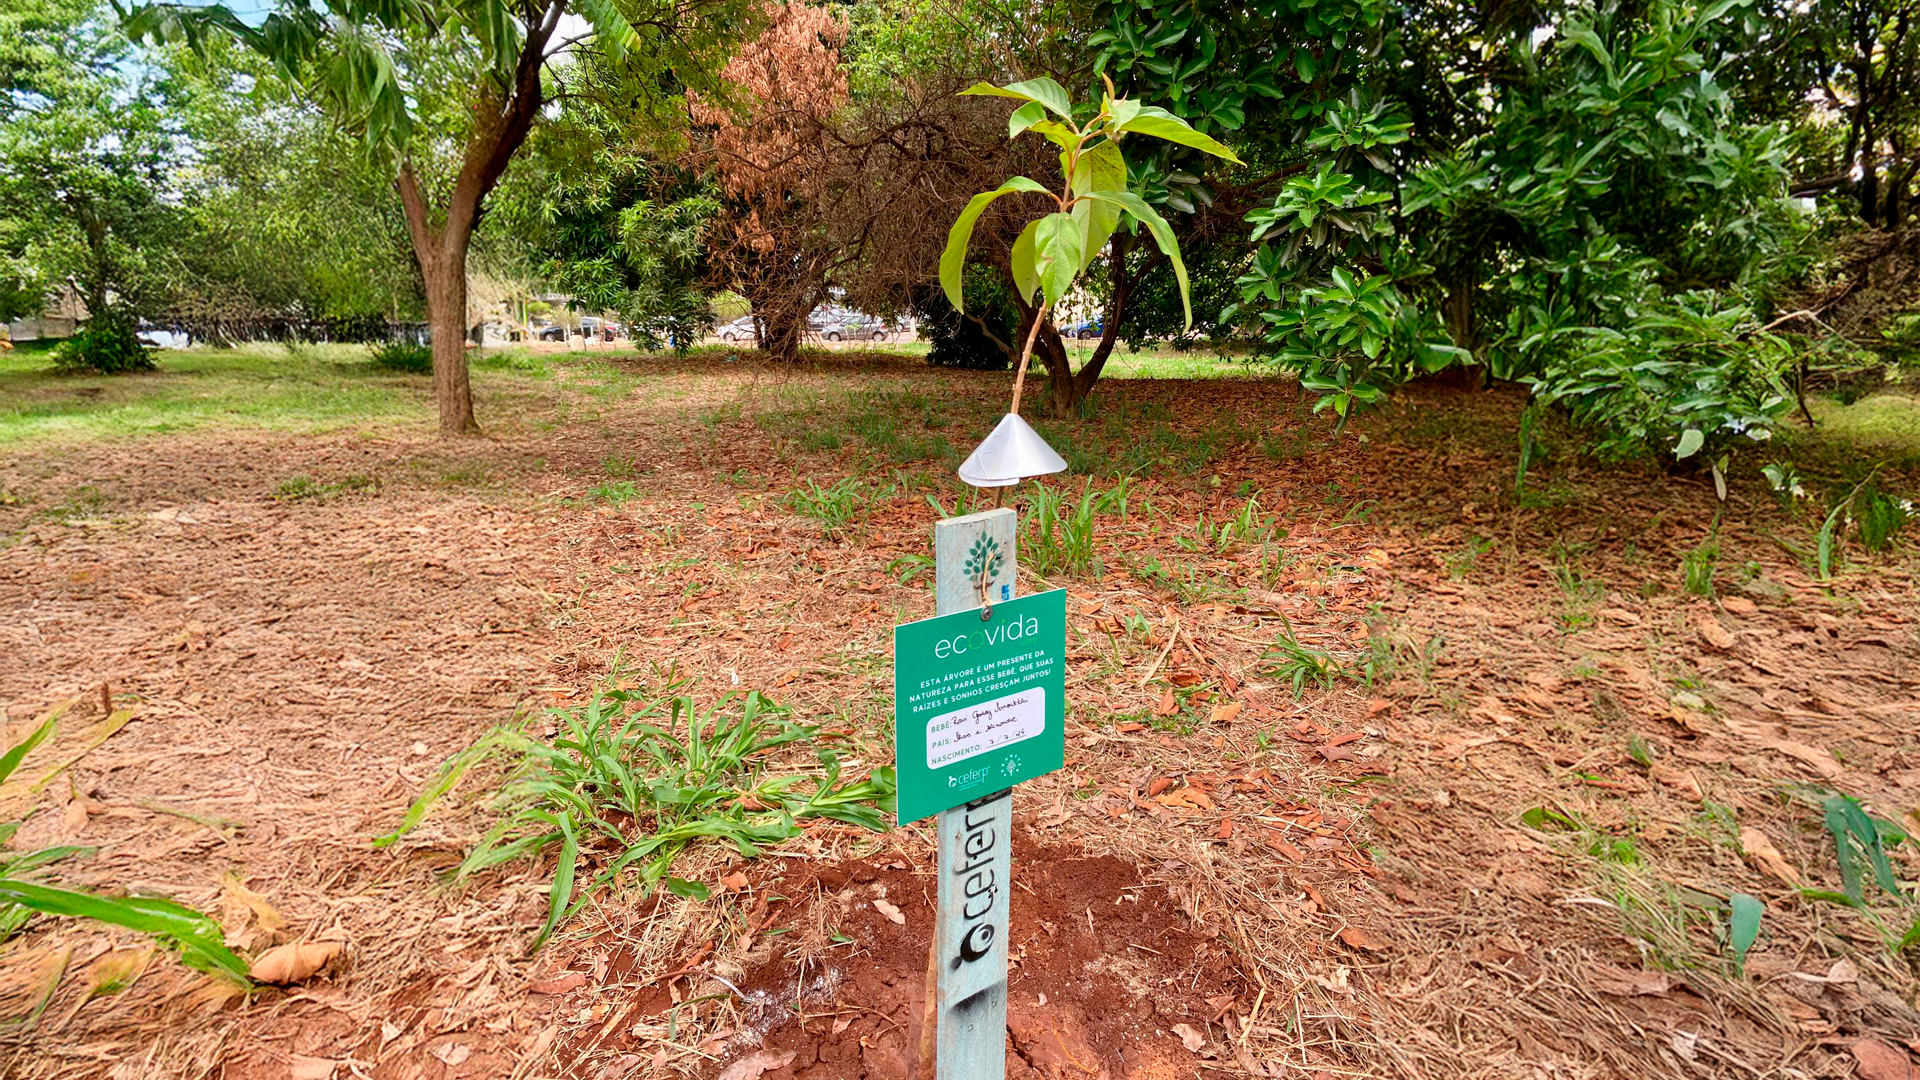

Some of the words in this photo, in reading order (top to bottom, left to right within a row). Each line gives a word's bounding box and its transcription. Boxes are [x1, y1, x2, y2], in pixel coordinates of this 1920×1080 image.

[935, 613, 1038, 659] ecovida
[909, 685, 952, 703] NATUREZA
[954, 679, 975, 691] PARA
[976, 673, 995, 684] ESSE
[1019, 662, 1034, 672] QUE
[1035, 657, 1054, 668] SUAS
[920, 677, 941, 689] ESTA
[943, 667, 975, 683] ÁRVORE
[976, 664, 982, 673] É
[983, 662, 996, 671] UM
[997, 652, 1033, 668] PRESENTE
[1034, 649, 1045, 658] DA
[912, 699, 942, 714] RAÍZES
[943, 697, 949, 705] E
[951, 687, 983, 703] SONHOS
[984, 677, 1020, 693] CRESÇAM
[1021, 668, 1051, 682] JUNTOS!
[931, 737, 952, 749] PAIS:
[931, 744, 982, 765] NASCIMENTO:
